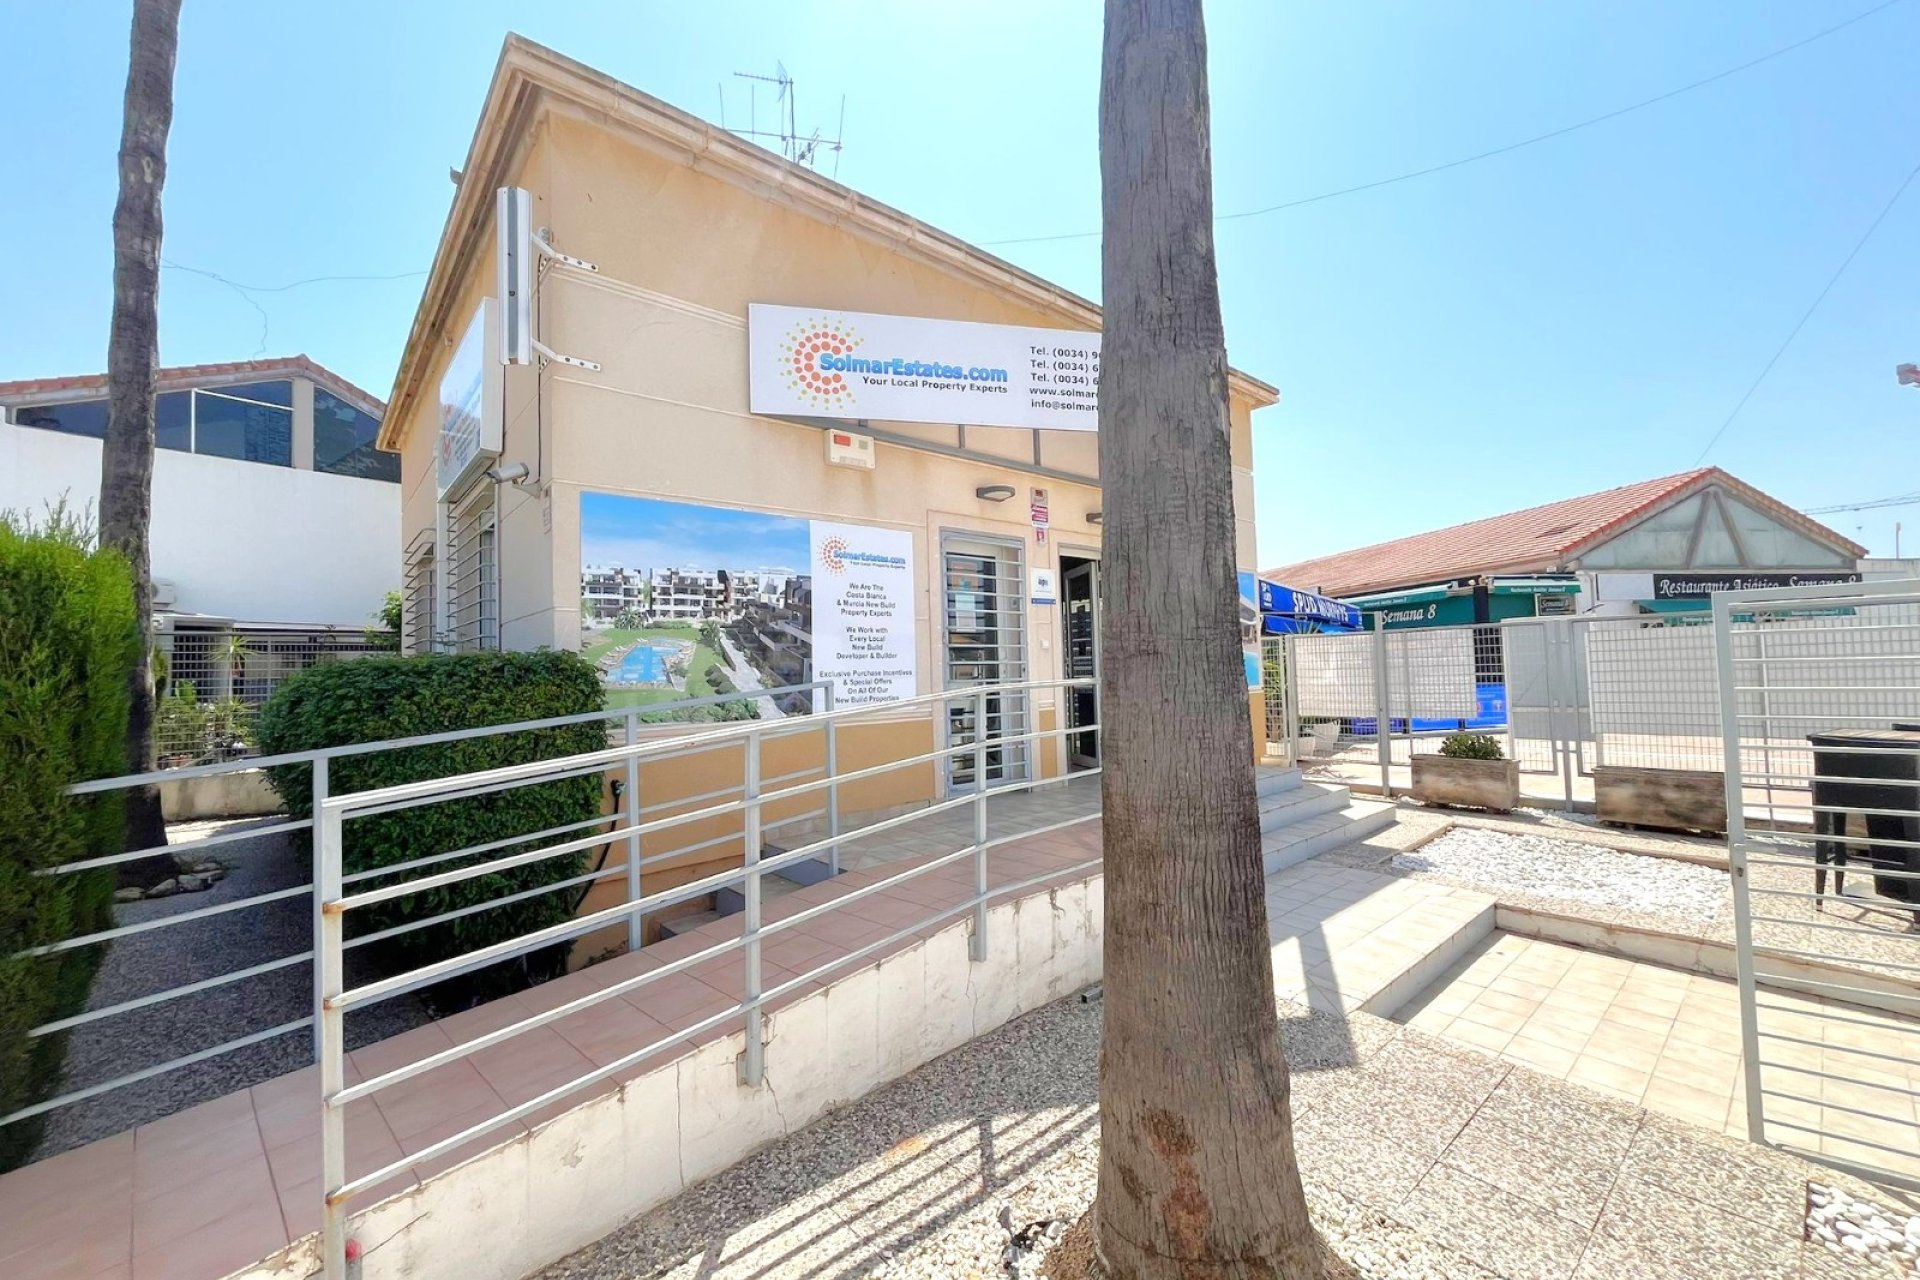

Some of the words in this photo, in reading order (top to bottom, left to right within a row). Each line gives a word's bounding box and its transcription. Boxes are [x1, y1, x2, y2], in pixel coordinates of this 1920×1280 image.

[1030, 346, 1049, 356] Tel.
[1053, 347, 1088, 360] (0034)
[820, 352, 1008, 383] SolmarEstates.com
[1030, 359, 1050, 369] Tel.
[1053, 361, 1089, 373] (0034)
[862, 376, 888, 386] Your
[891, 378, 918, 388] Local
[922, 380, 967, 392] Property
[969, 382, 1008, 394] Experts
[1030, 372, 1050, 382] Tel.
[1053, 374, 1089, 386] (0034)
[1659, 579, 1730, 597] Restaurante
[846, 591, 865, 599] Costa
[866, 592, 887, 600] Blanca
[1292, 591, 1318, 614] SPUD
[840, 608, 868, 617] Property
[1381, 609, 1425, 625] Semana
[1427, 603, 1437, 619] 8
[846, 626, 857, 634] We
[857, 626, 874, 634] Work
[849, 635, 867, 643] Every
[836, 652, 869, 660] Developer
[819, 670, 852, 678] Exclusive
[852, 669, 882, 677] Purchase
[868, 695, 900, 703] Properties
